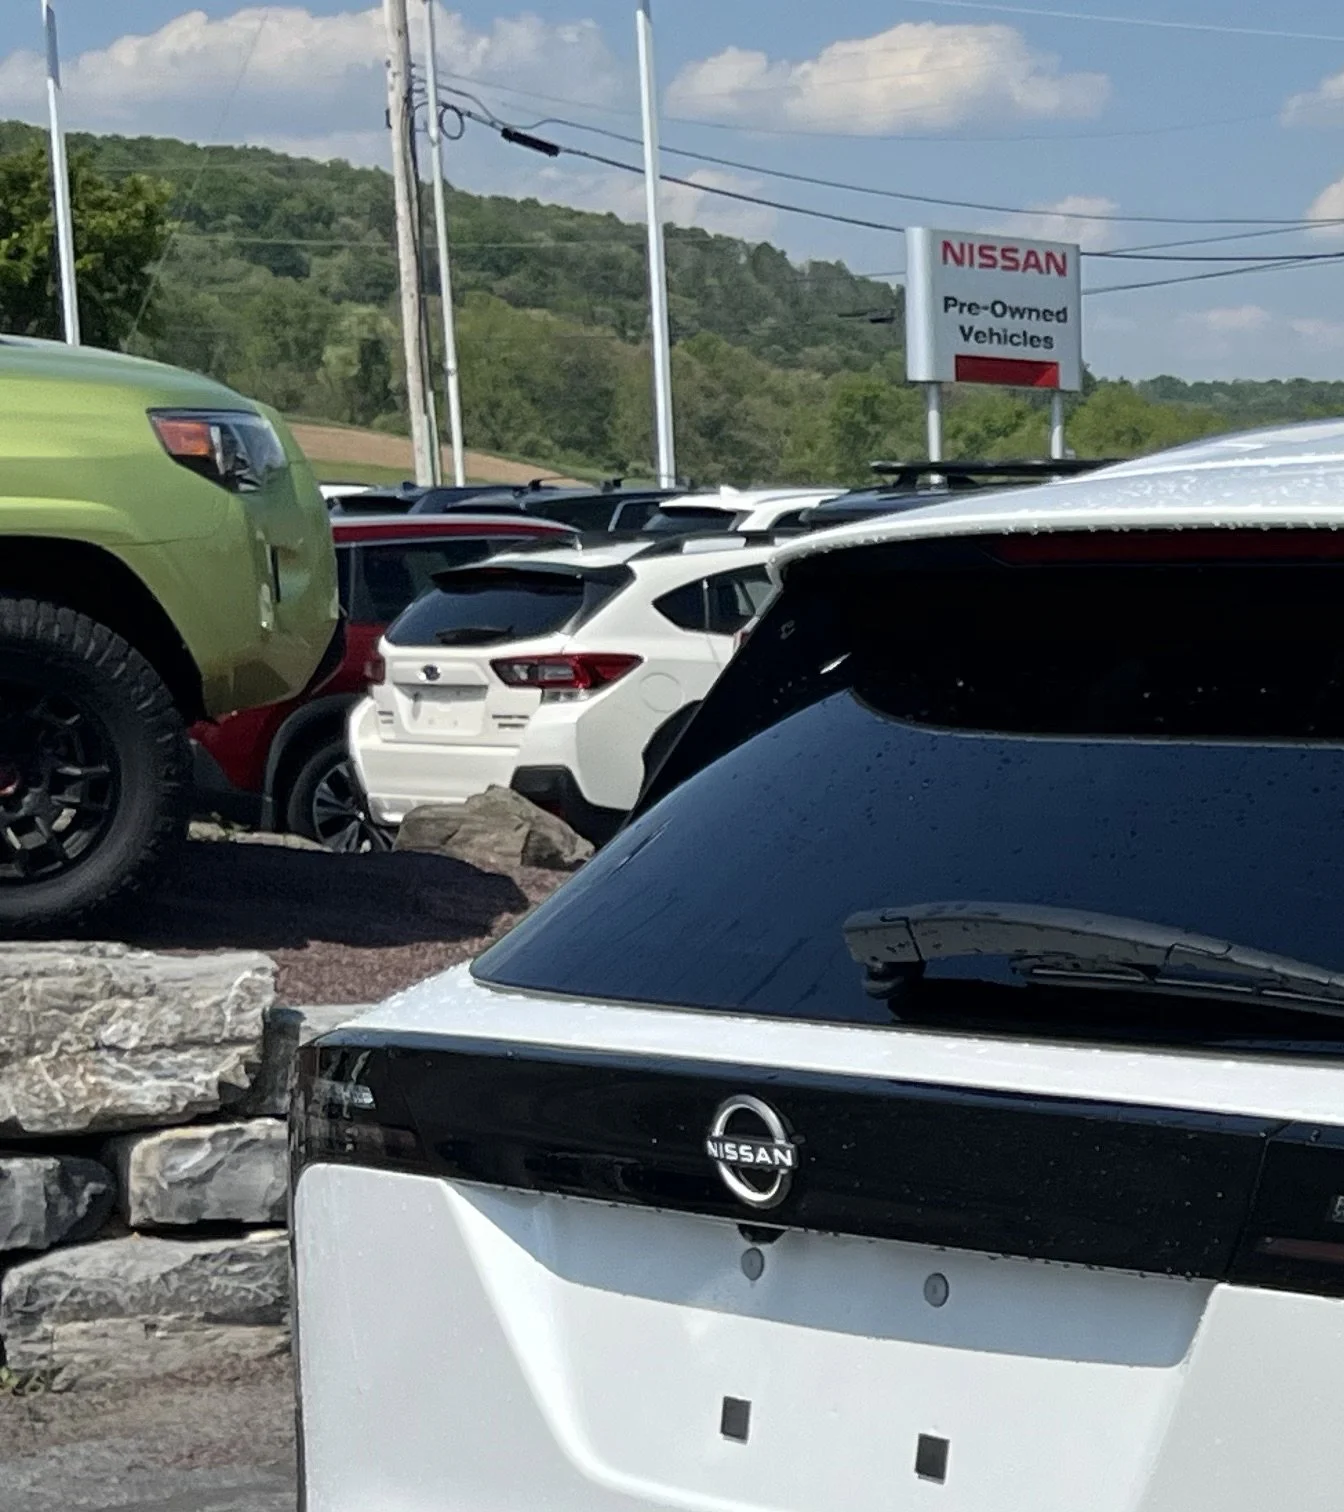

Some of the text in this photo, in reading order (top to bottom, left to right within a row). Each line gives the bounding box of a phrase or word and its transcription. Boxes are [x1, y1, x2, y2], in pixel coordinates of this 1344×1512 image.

[942, 240, 1067, 277] NISSAN
[943, 296, 1068, 323] Pre-Owned
[959, 325, 1054, 349] Vehicles
[706, 1140, 793, 1167] NISSAN
